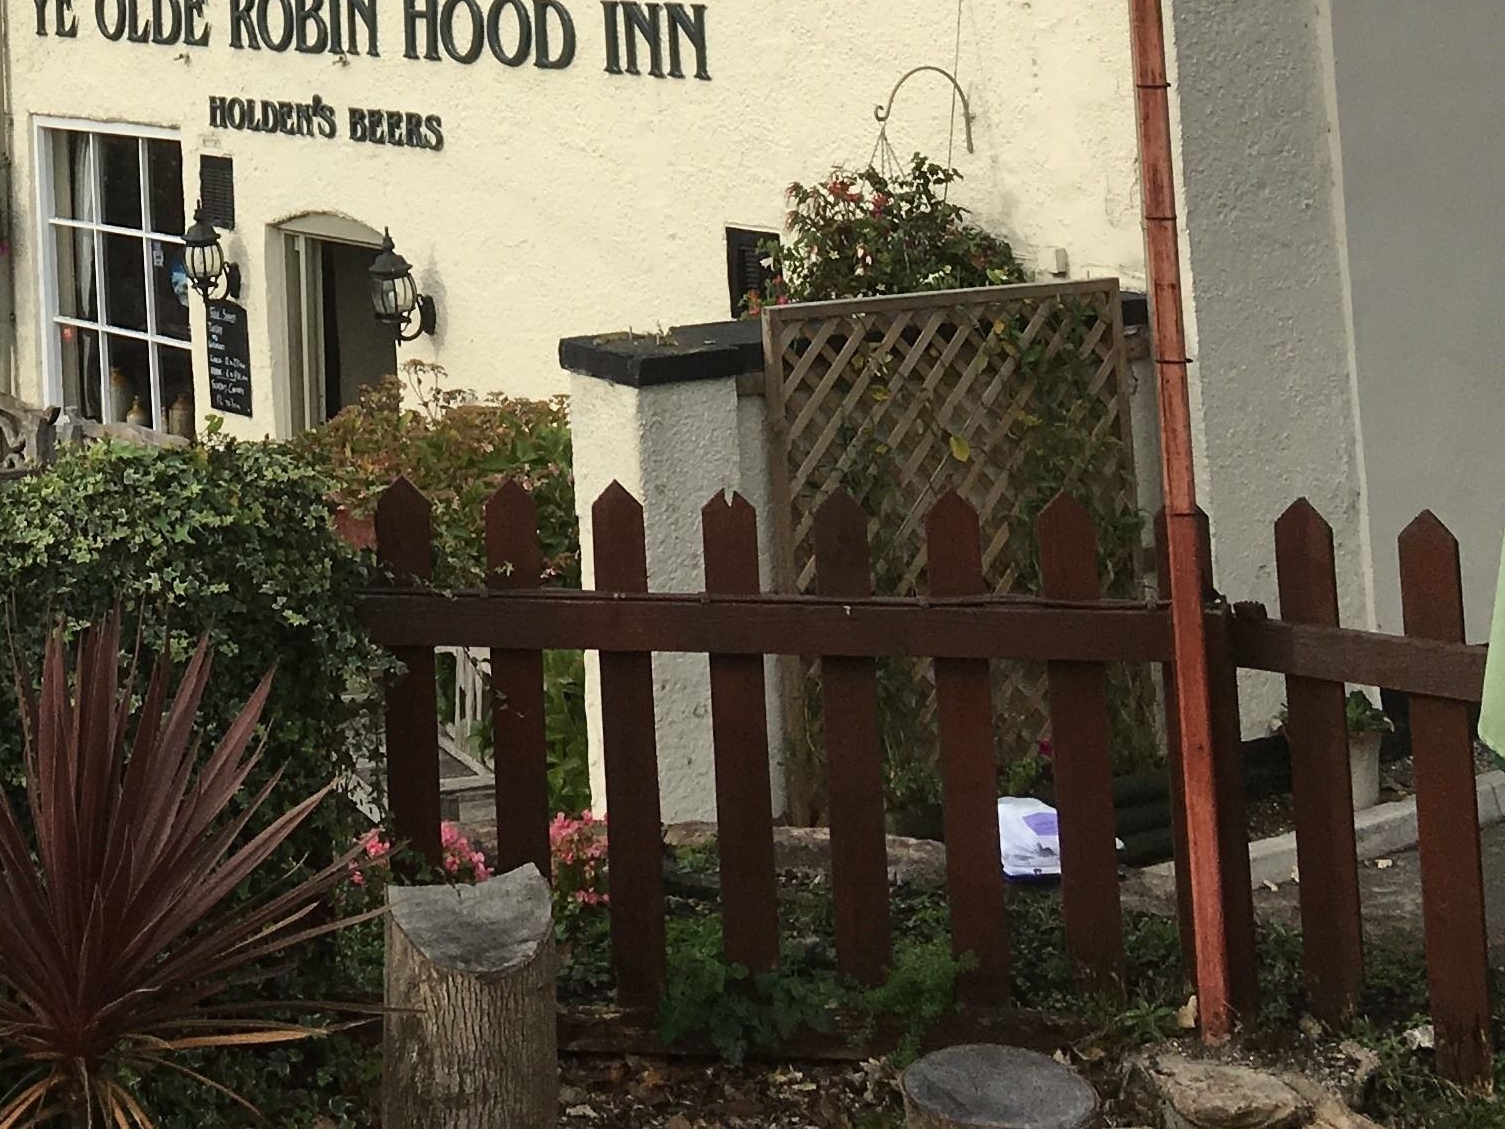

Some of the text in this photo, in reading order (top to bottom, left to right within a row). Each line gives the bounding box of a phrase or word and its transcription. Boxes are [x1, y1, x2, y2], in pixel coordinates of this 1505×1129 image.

[601, 0, 713, 81] INN
[208, 93, 445, 152] HOLDEN'S BEERS
